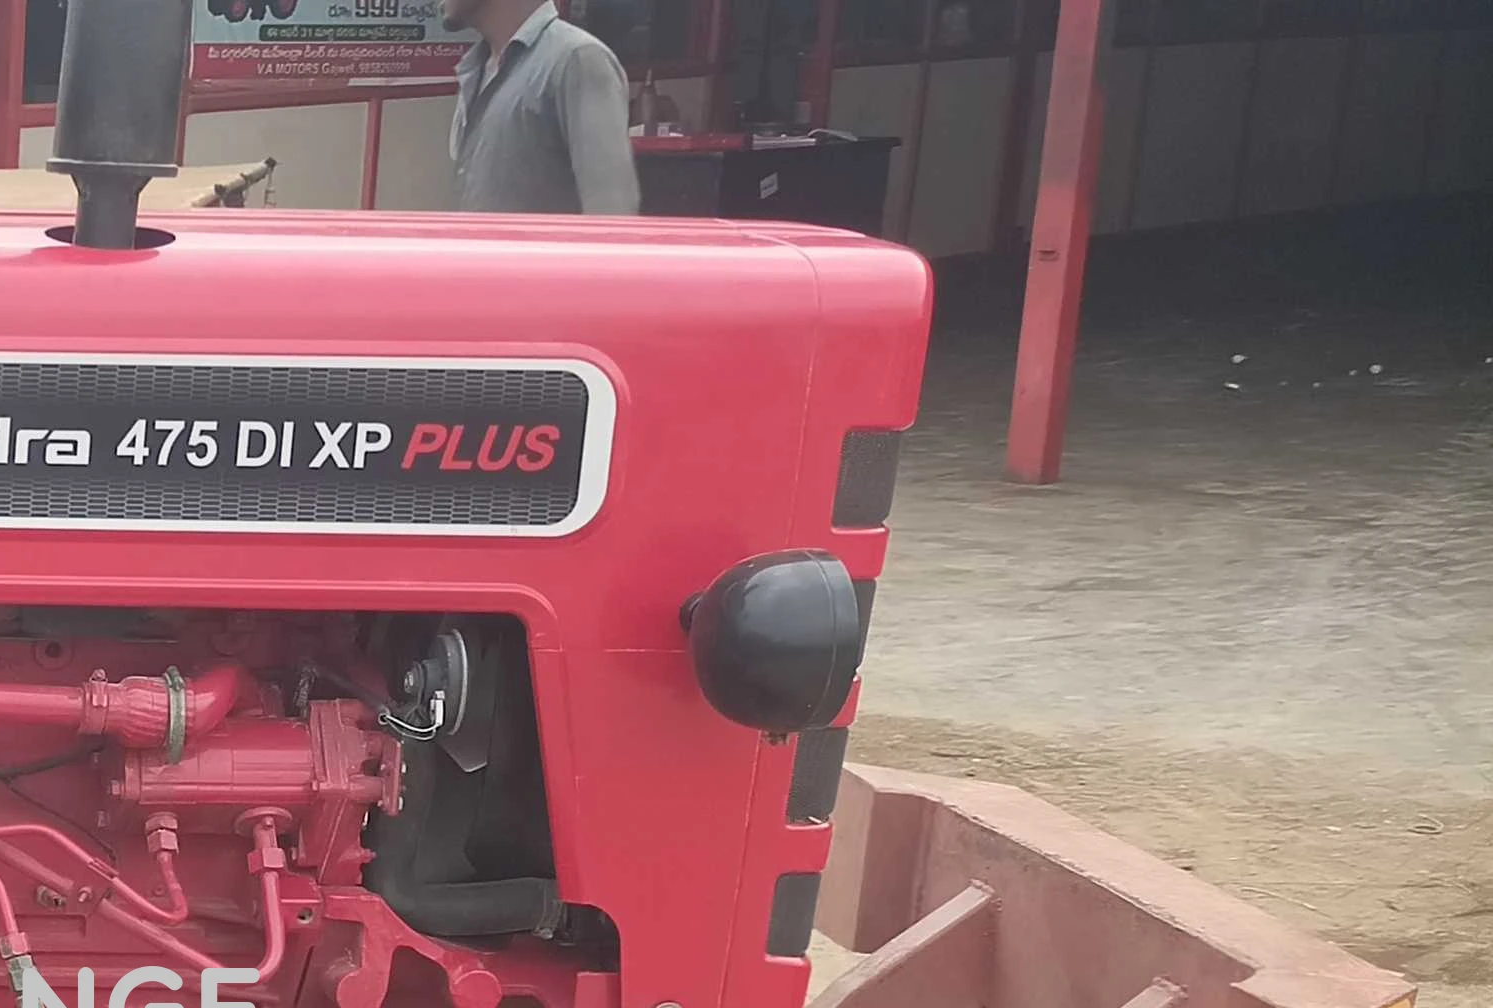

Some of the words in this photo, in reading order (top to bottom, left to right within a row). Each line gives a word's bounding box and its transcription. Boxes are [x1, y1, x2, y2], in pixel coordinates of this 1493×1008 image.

[275, 62, 320, 75] MOTORS
[116, 419, 217, 467] 475
[236, 420, 293, 468] DI
[309, 421, 391, 469] XP
[401, 423, 561, 471] PLUS
